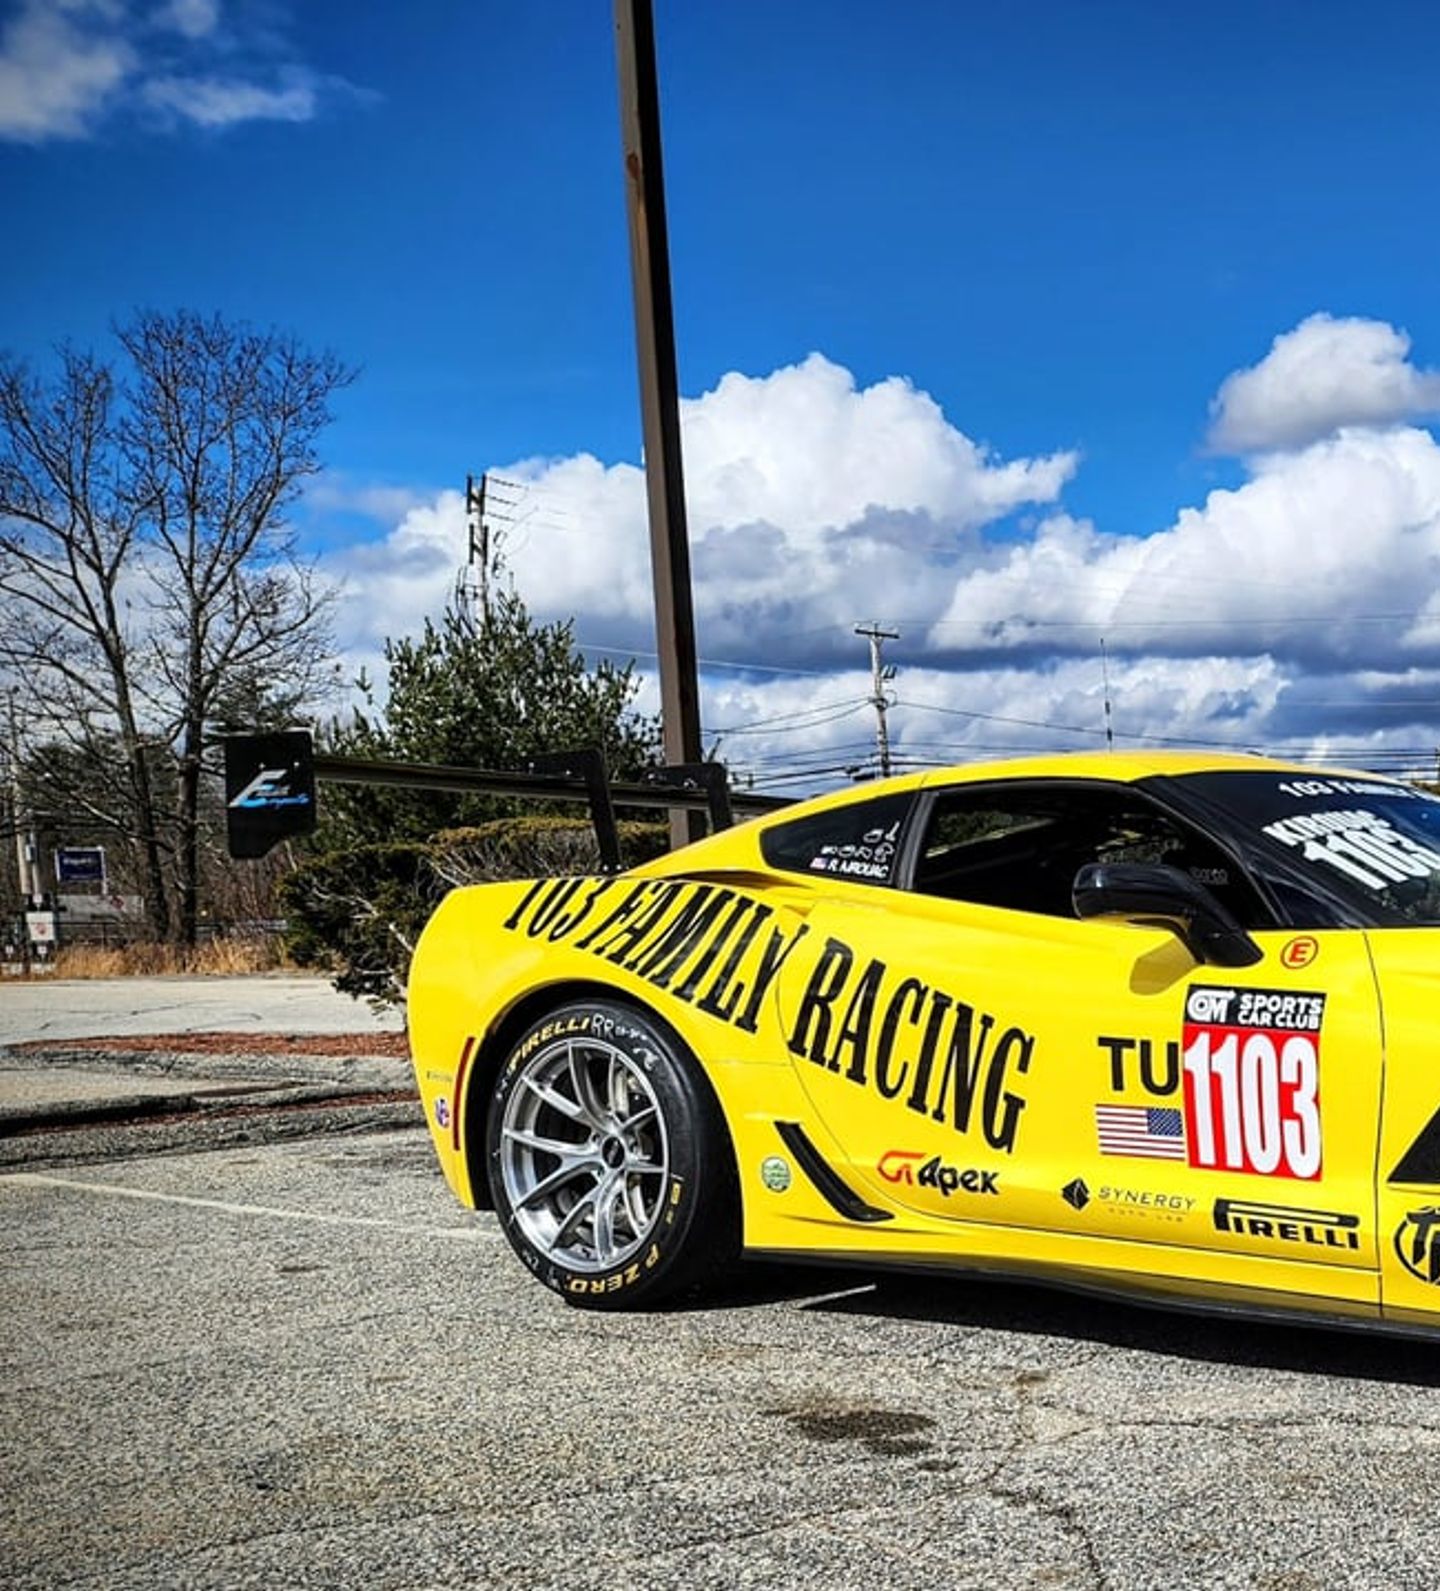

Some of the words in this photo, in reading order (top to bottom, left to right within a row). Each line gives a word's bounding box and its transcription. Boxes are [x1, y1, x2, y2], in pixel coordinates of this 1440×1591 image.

[503, 878, 616, 942] 103
[574, 879, 809, 1033] FAMILY
[787, 936, 1035, 1155] RACING
[1237, 1009, 1272, 1027] CAR
[1275, 1012, 1319, 1030] CLUB
[1239, 993, 1323, 1015] SPORTS
[506, 1016, 590, 1077] PIRELLI
[1097, 1036, 1180, 1097] TU
[1184, 1031, 1321, 1179] 1103
[917, 1156, 1001, 1197] Apex
[1098, 1185, 1197, 1211] SYNERGY
[1213, 1198, 1360, 1250] PIRELLI
[568, 1262, 641, 1294] ZERO
